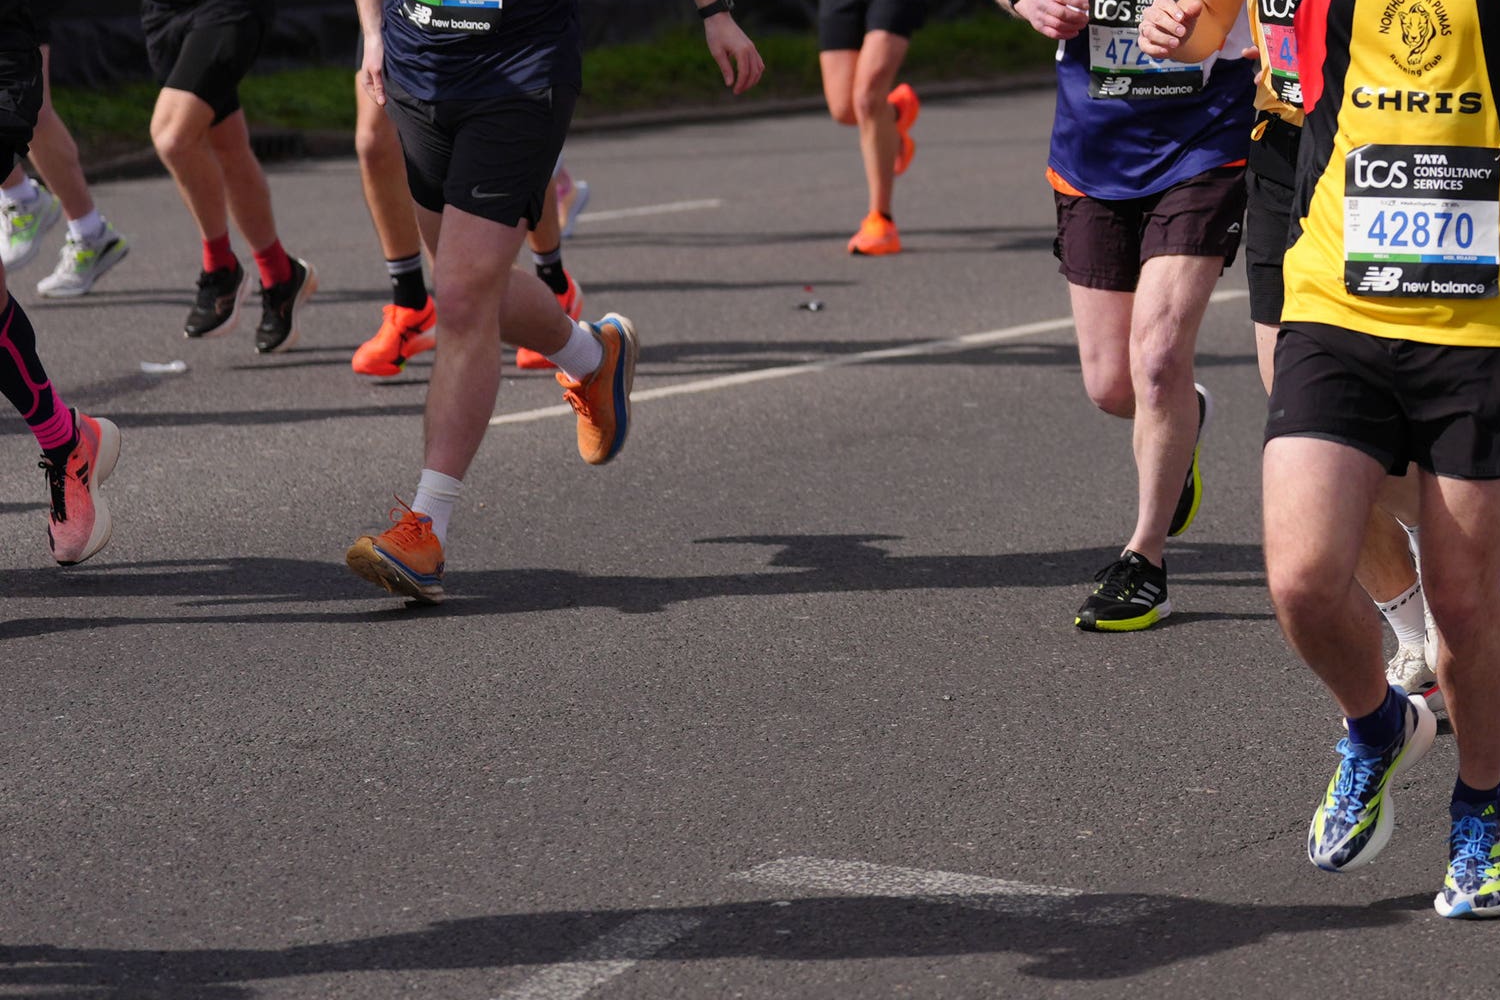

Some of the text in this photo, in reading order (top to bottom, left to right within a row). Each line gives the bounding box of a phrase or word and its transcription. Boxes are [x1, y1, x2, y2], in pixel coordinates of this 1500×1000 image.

[432, 18, 491, 30] new balance
[1433, 0, 1453, 36] PUMAS
[1105, 37, 1184, 66] 472
[1390, 53, 1442, 77] Running Club
[1132, 85, 1193, 96] new balance
[1351, 86, 1483, 115] CHRIS
[1413, 153, 1448, 165] TATA
[1354, 153, 1408, 189] tcs
[1413, 166, 1492, 179] CONSULTANCY
[1413, 179, 1463, 191] SERVICES
[1367, 210, 1474, 249] 42870
[1402, 280, 1485, 294] new balance
